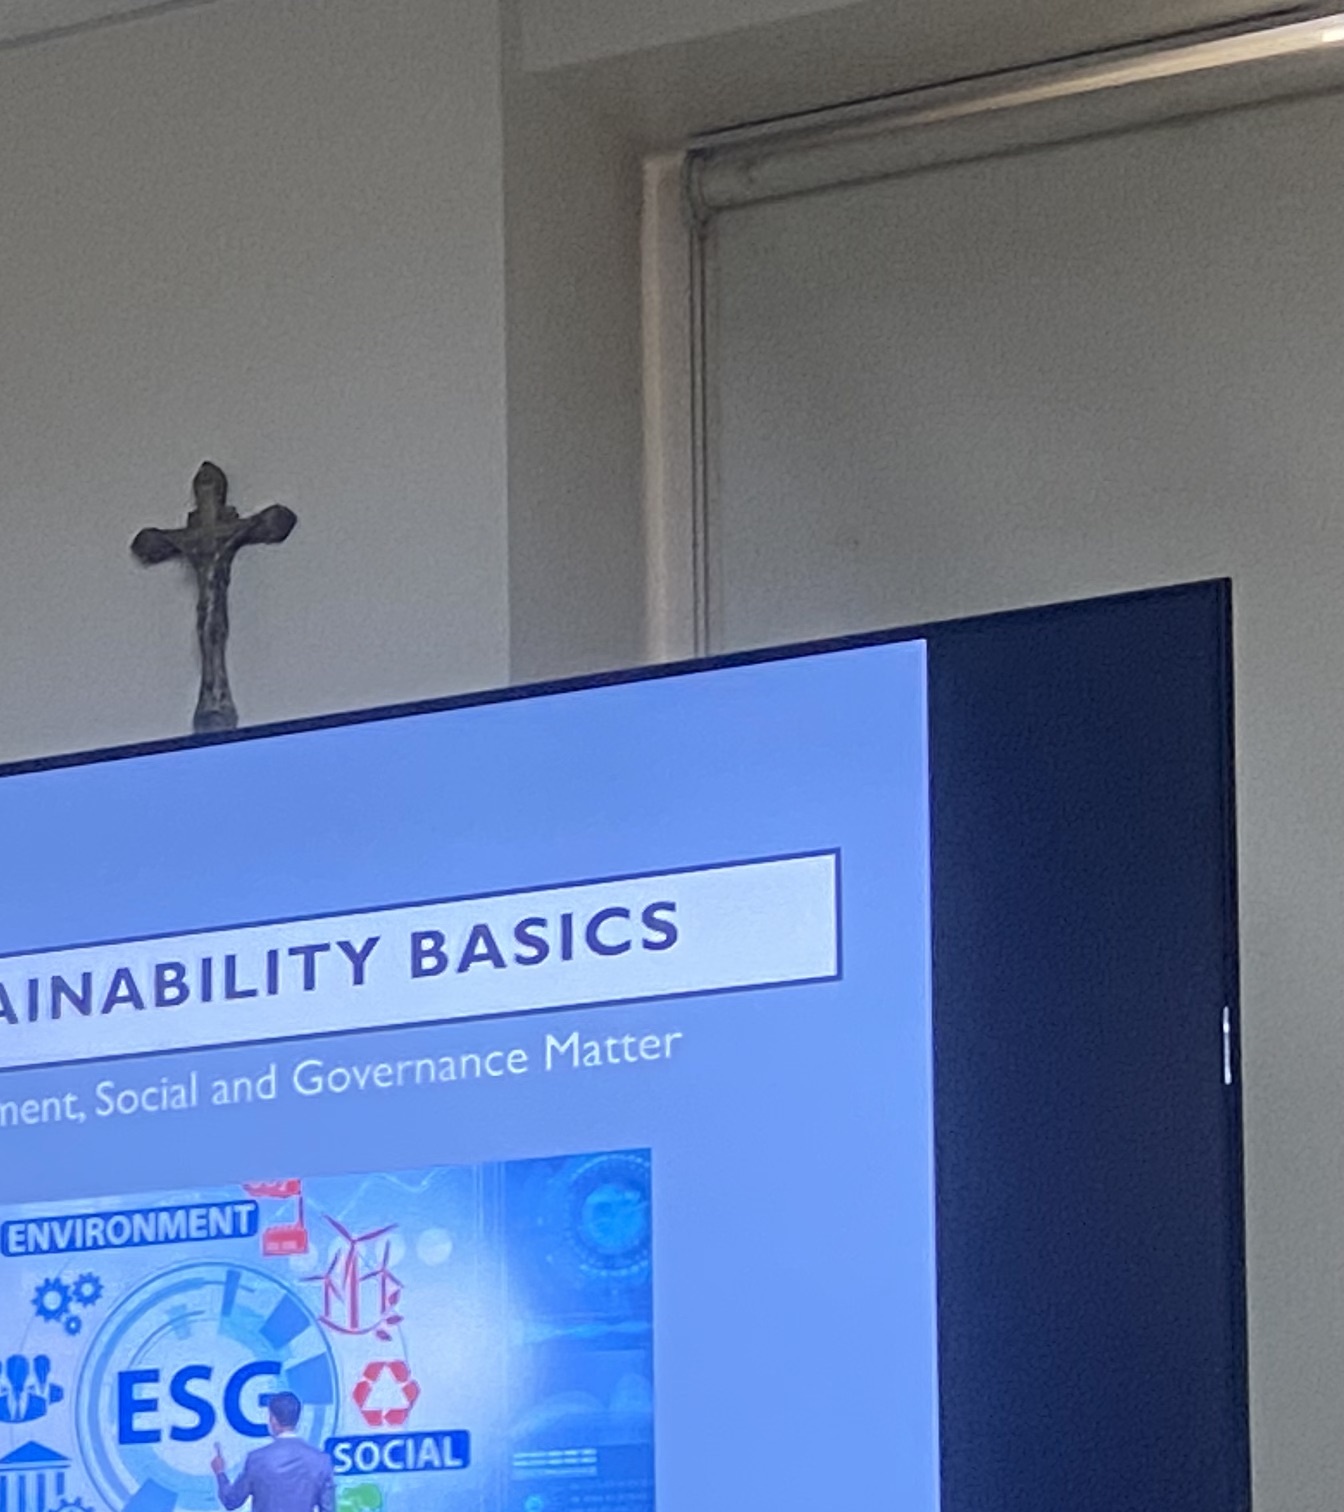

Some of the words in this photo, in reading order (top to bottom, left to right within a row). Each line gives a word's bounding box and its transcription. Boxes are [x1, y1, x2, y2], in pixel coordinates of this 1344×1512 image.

[411, 900, 679, 979] BASICS
[95, 1070, 199, 1118] Social
[210, 1063, 277, 1105] and
[292, 1047, 529, 1097] Governance
[545, 1030, 684, 1072] Matter
[7, 1203, 256, 1254] ENVIRONMENT
[116, 1360, 285, 1446] ESG
[332, 1435, 463, 1473] SOCIAL
